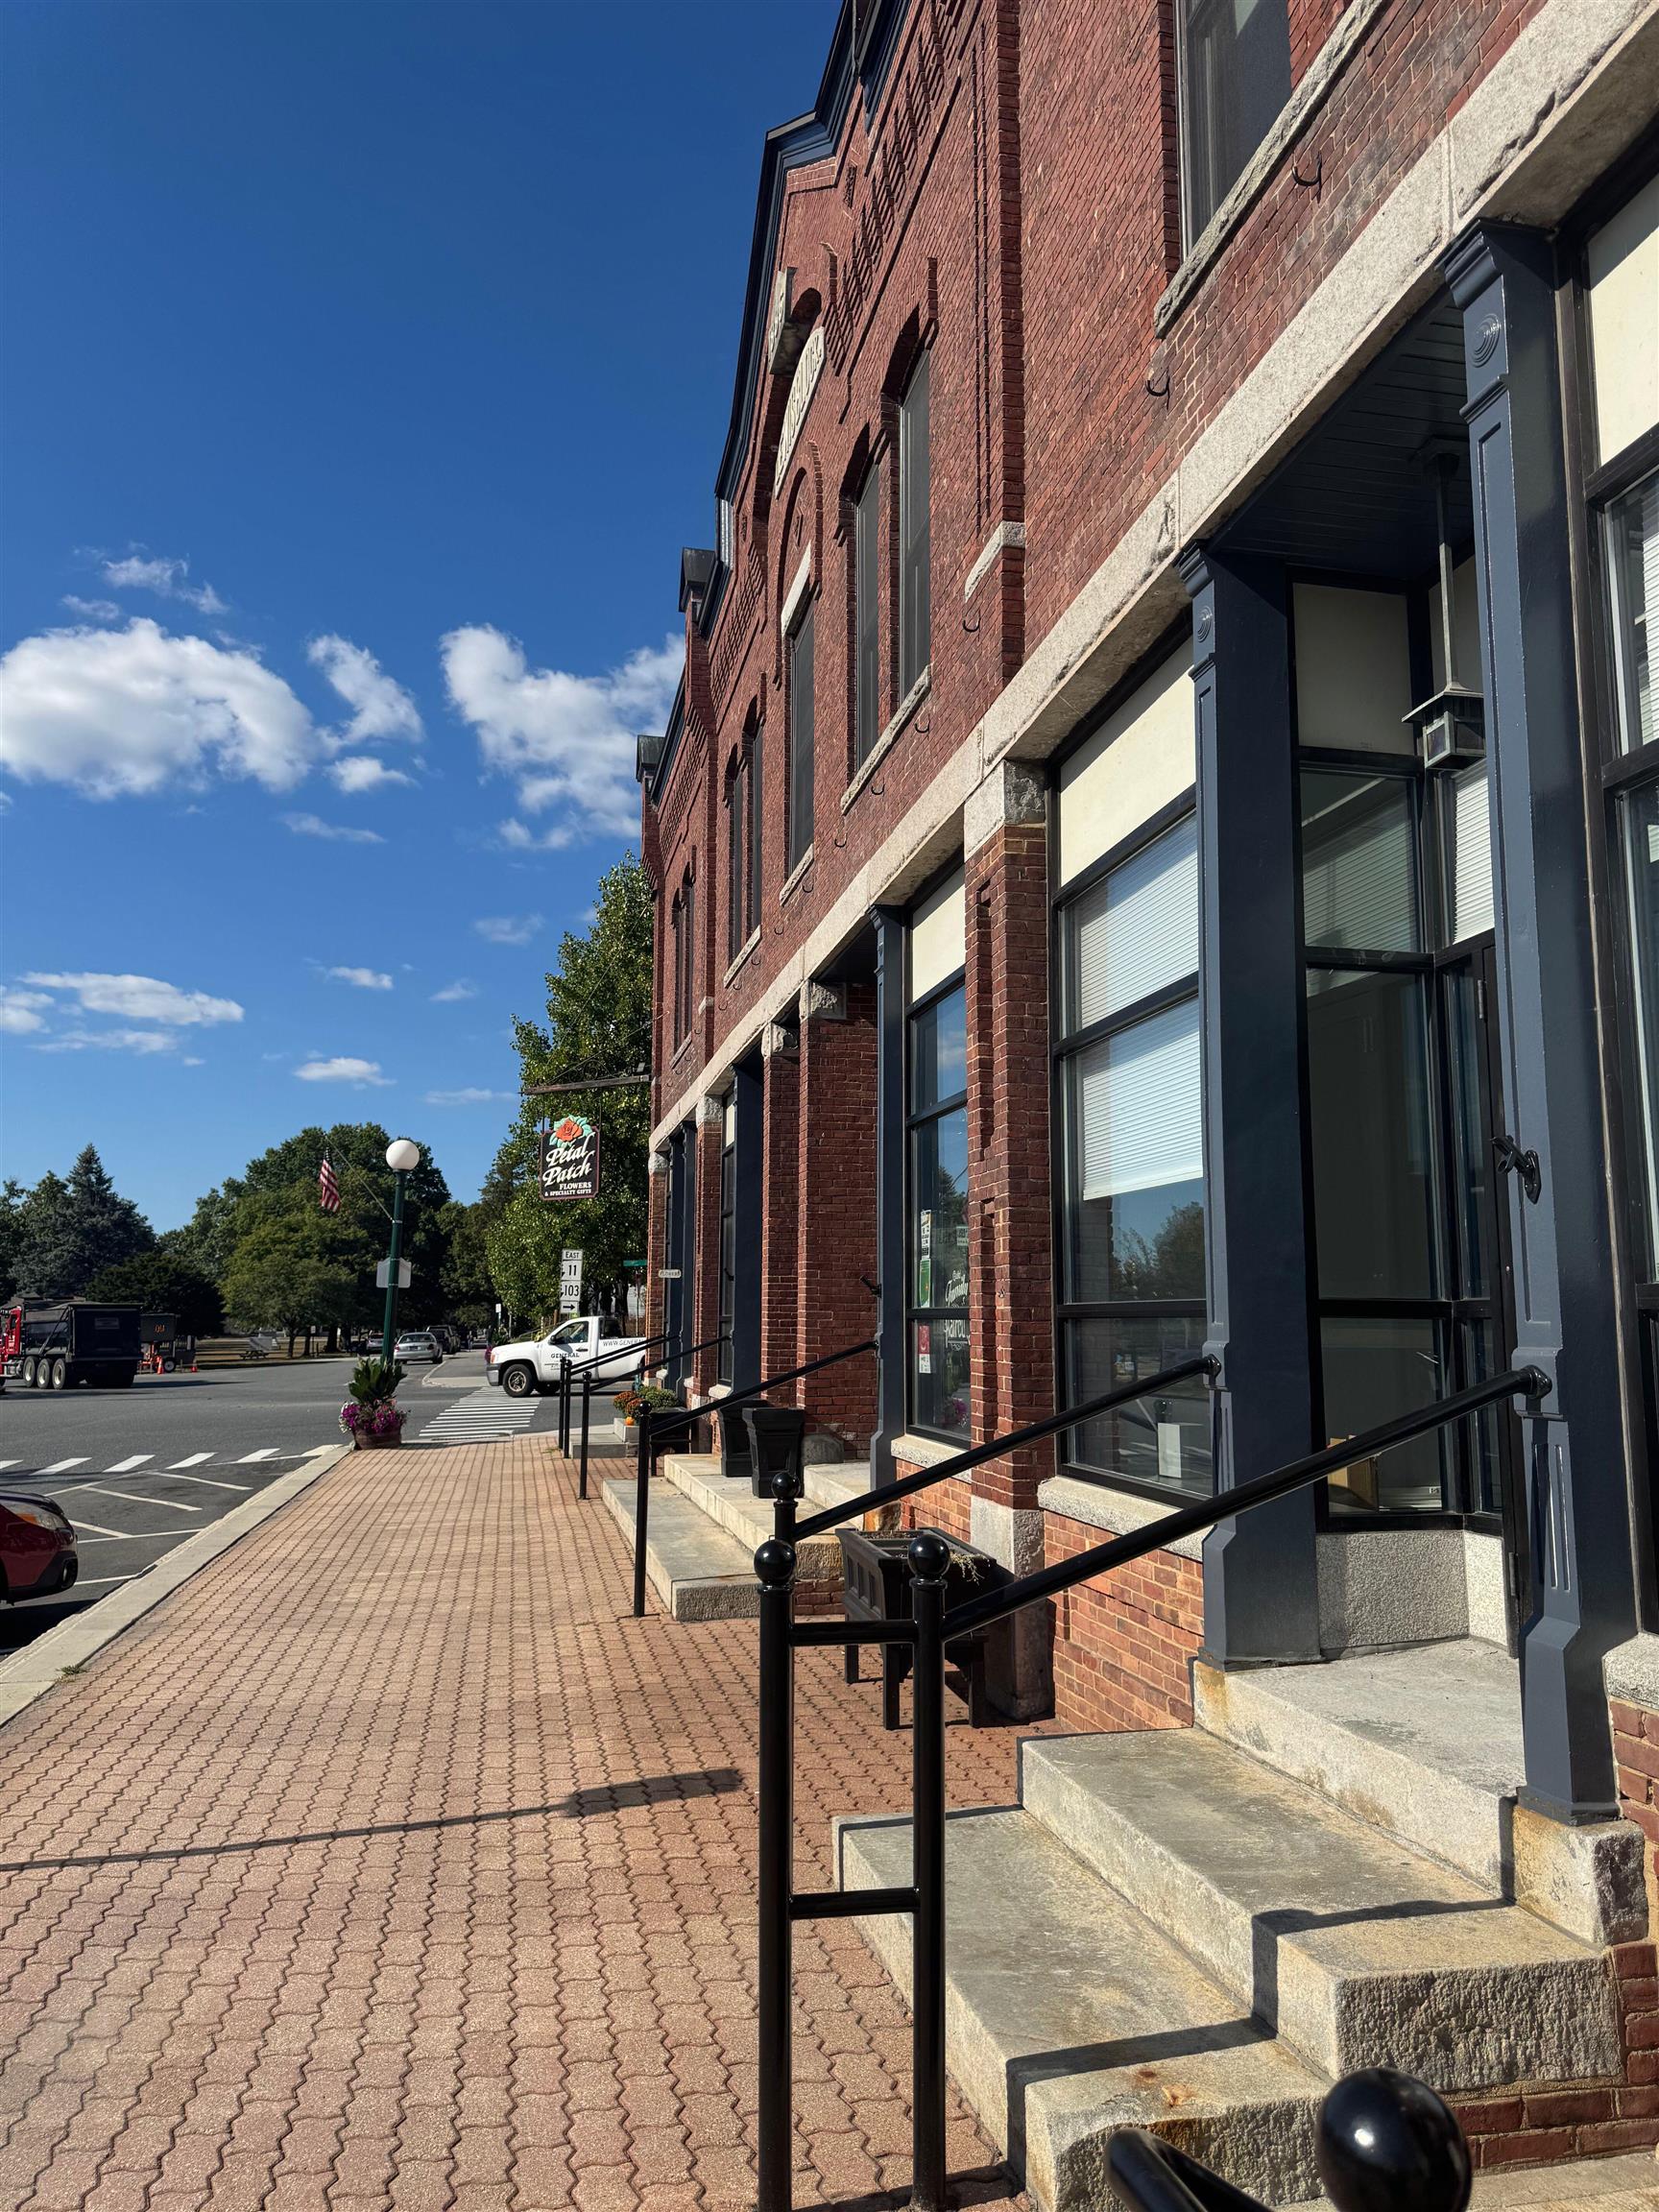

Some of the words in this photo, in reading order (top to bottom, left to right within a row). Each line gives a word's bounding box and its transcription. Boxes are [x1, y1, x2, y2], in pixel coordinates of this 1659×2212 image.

[545, 1131, 596, 1167] Petal
[542, 1150, 595, 1188] Patch
[559, 1181, 592, 1190] FLOWERS
[568, 1264, 577, 1276] 11
[565, 1285, 580, 1297] 103
